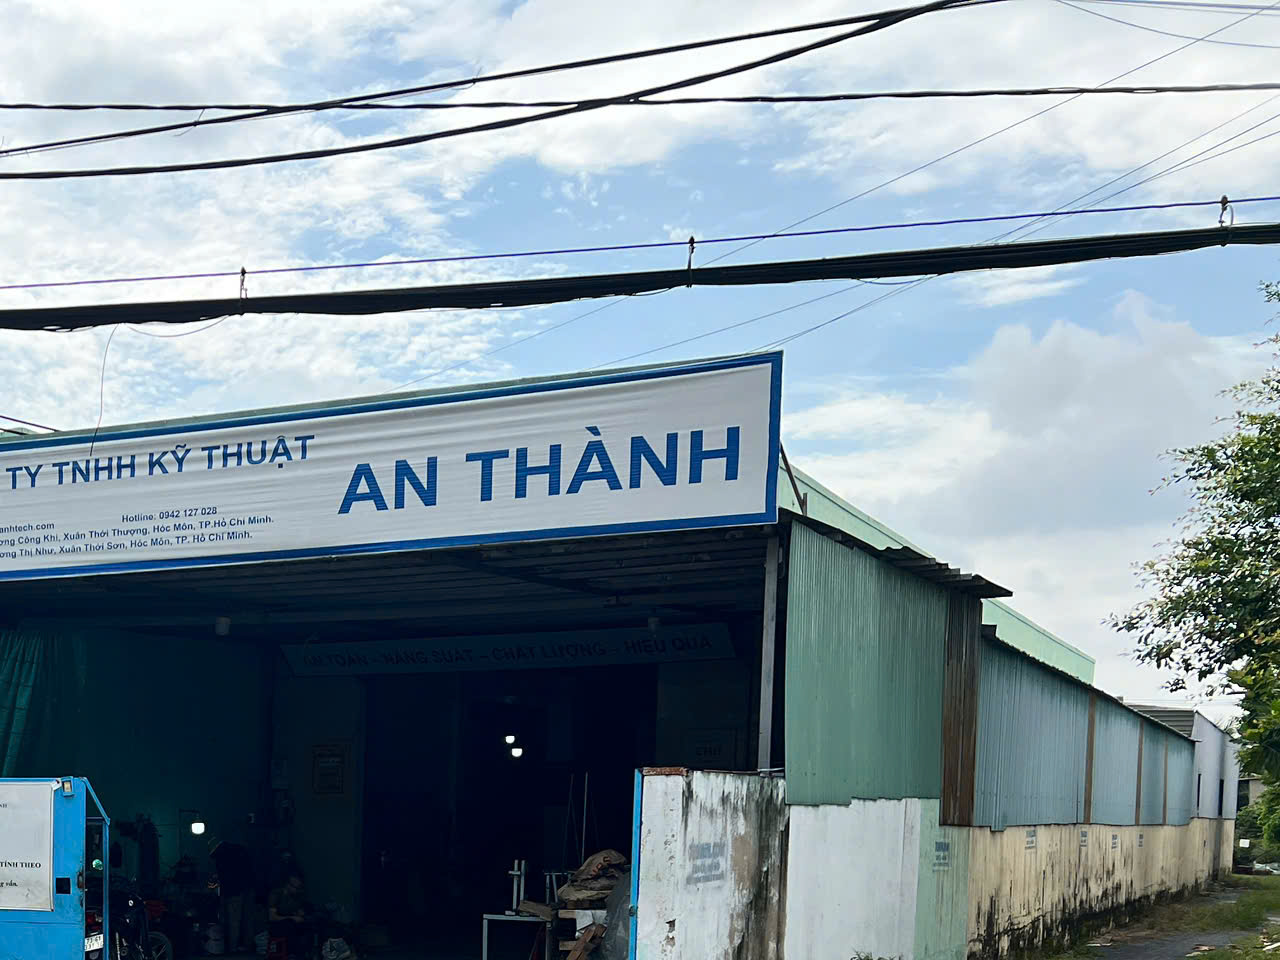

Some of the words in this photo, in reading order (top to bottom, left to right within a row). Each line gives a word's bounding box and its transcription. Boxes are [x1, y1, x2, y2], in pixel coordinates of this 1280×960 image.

[6, 464, 44, 490] TY
[52, 454, 136, 486] TNHH
[148, 443, 192, 476] KỸ
[201, 434, 315, 470] THUẬT
[337, 456, 438, 515] AN
[465, 426, 740, 502] THÀNH
[18, 534, 41, 547] Công
[63, 530, 86, 541] Xuân
[111, 526, 150, 540] Thượng,
[152, 522, 171, 533] Hóc
[173, 521, 196, 533] Môn,
[247, 514, 274, 526] Minh.
[121, 512, 157, 523] Hotline:
[159, 509, 180, 520] 0942
[183, 508, 198, 518] 127
[200, 506, 217, 516] 028
[59, 542, 82, 554] Xuân
[106, 540, 128, 551] Sơn,
[130, 537, 149, 549] Hóc
[150, 536, 173, 549] Môn,
[175, 535, 192, 546] TP.
[226, 530, 253, 541] Minh.
